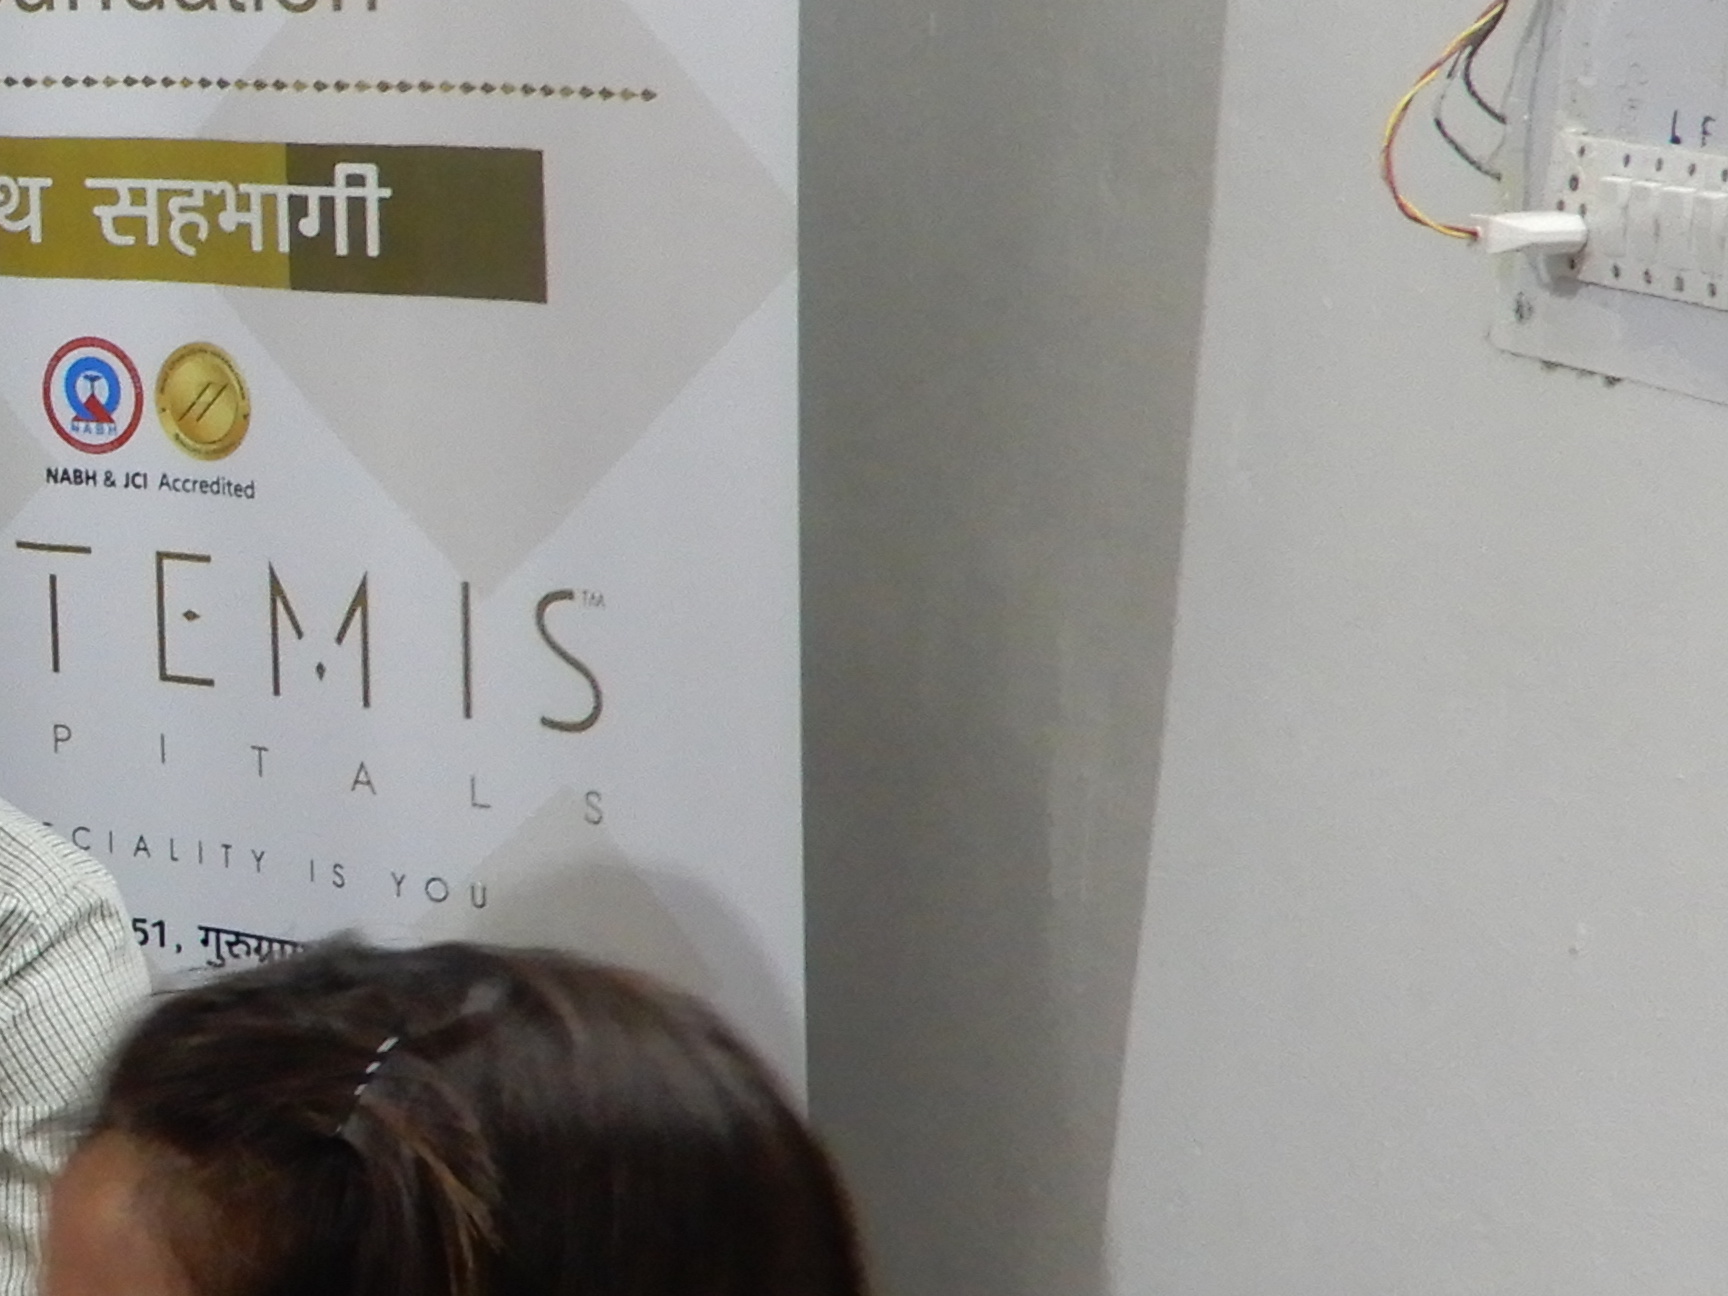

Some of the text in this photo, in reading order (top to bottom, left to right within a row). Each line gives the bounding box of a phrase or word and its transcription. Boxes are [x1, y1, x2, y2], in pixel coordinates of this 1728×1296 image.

[84, 161, 392, 259] सहभागी
[71, 422, 117, 436] NABH
[46, 467, 255, 499] NABH & JCI Accredited
[71, 826, 487, 909] CIALITY IS YOU
